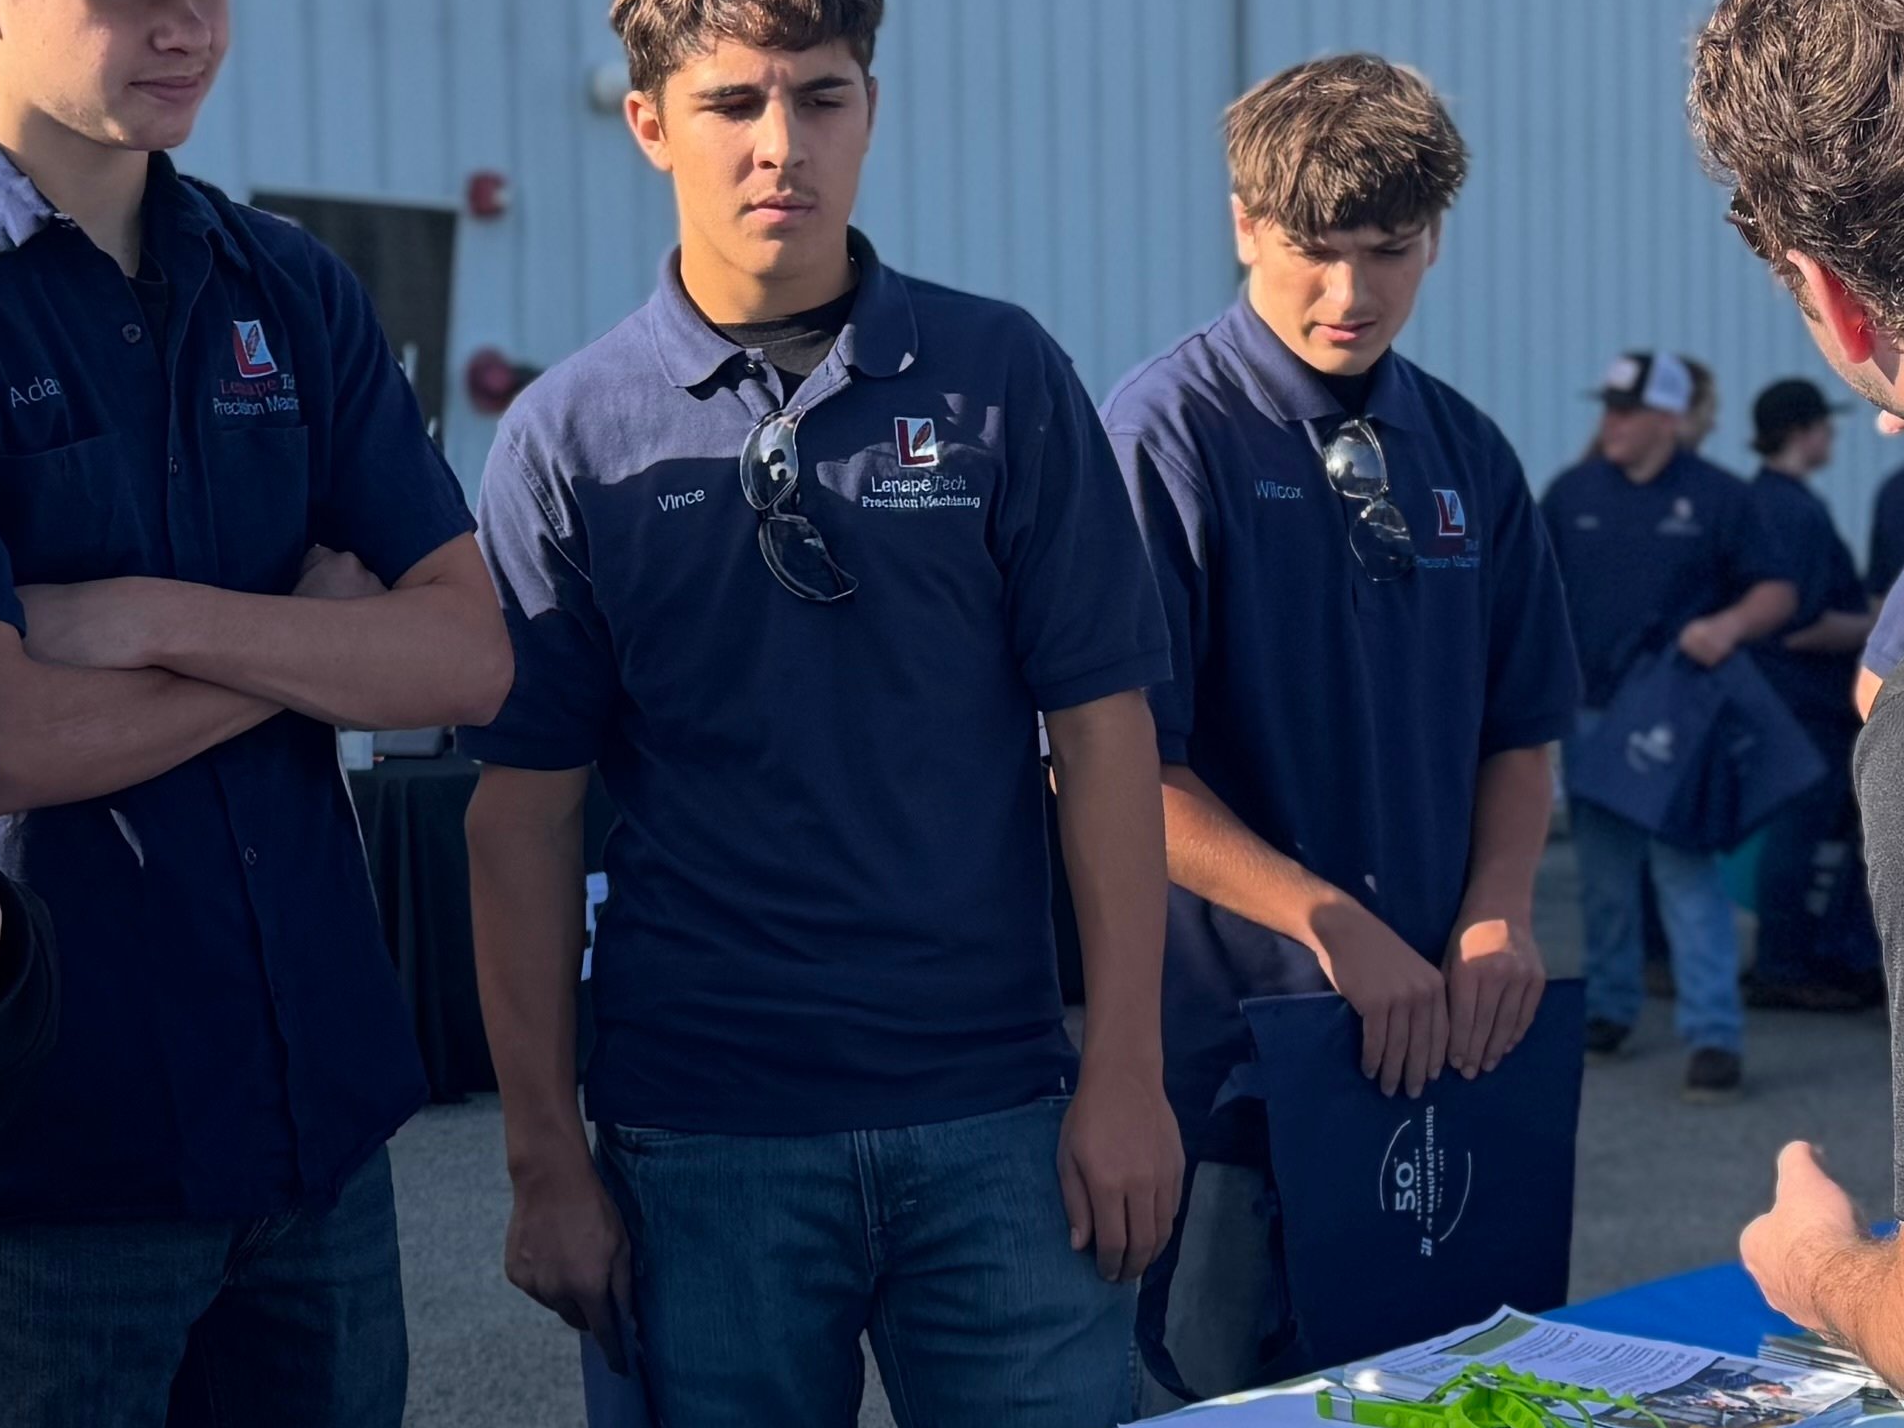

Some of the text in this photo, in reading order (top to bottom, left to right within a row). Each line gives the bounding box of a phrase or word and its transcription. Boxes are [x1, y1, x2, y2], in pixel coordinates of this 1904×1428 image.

[10, 378, 62, 408] Ada
[657, 489, 706, 511] Vince
[861, 495, 919, 509] Precision
[1394, 1161, 1416, 1211] 50
